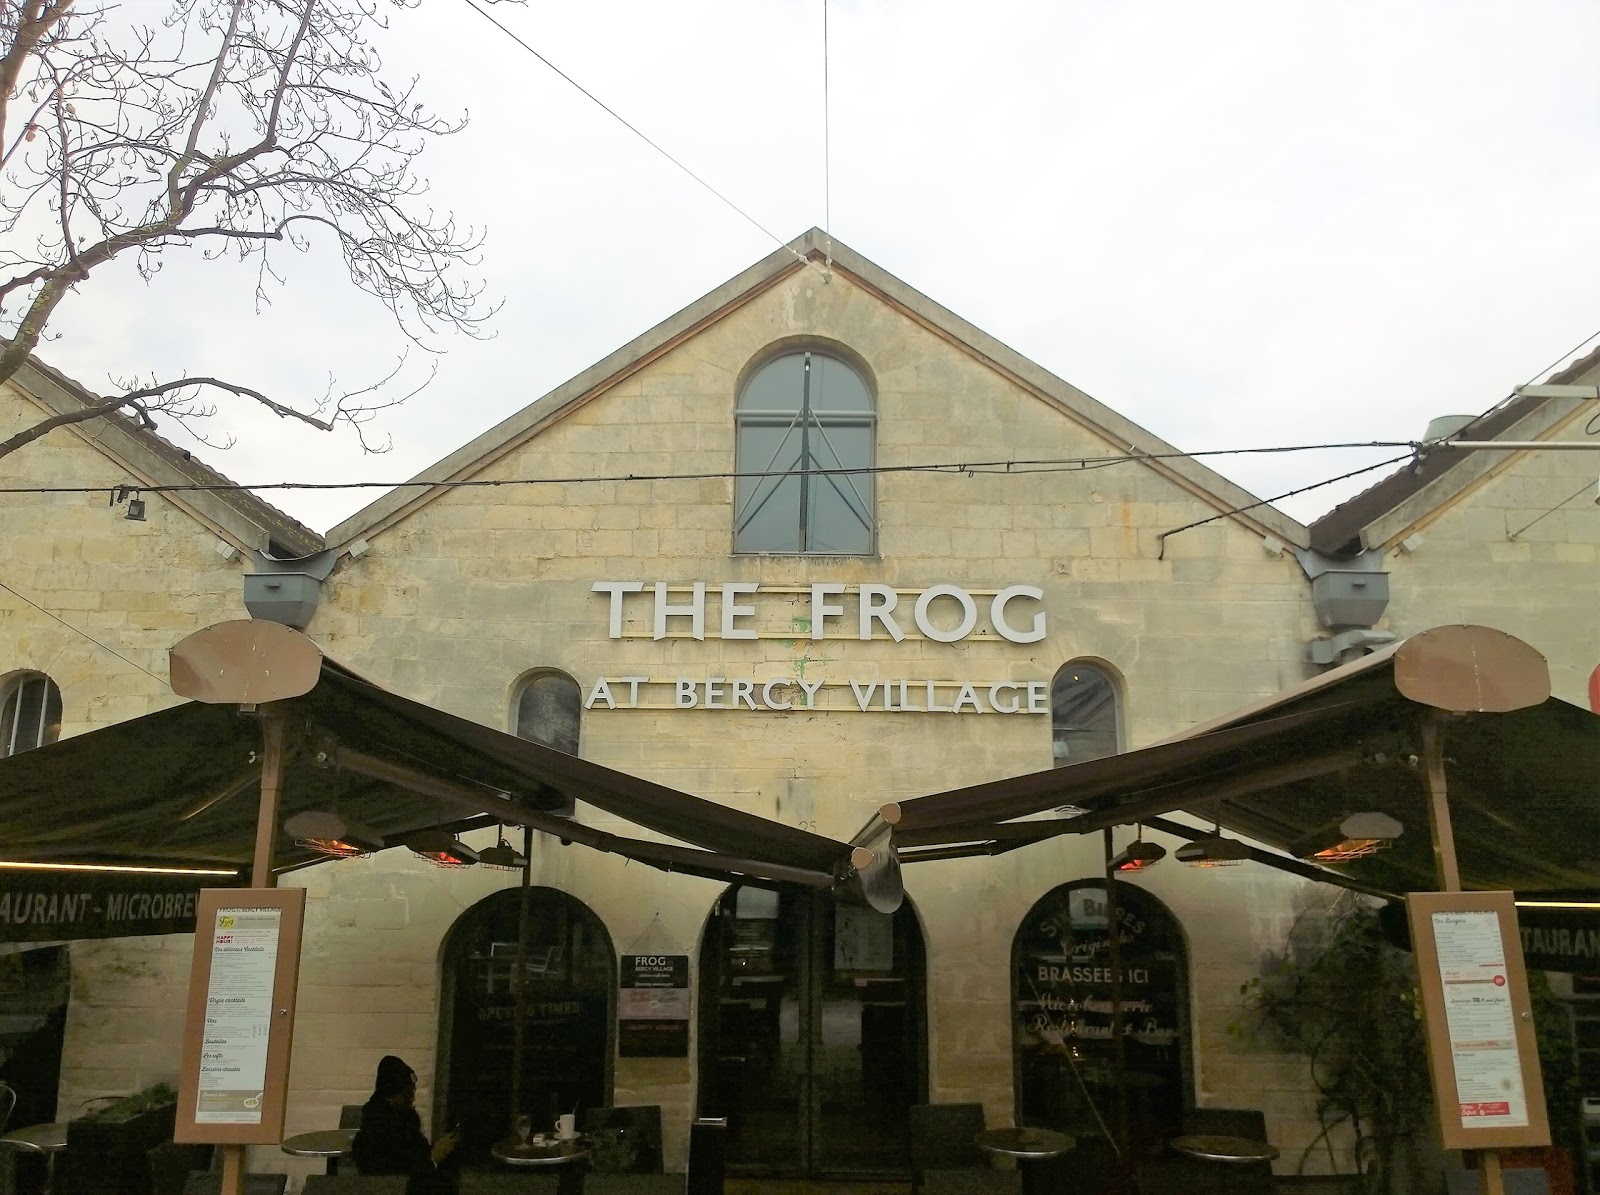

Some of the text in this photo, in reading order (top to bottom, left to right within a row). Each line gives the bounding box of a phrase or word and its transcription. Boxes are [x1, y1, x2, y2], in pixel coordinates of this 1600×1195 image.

[591, 582, 1047, 644] THE FROG
[584, 677, 1049, 714] AT BERCY VILLAGE
[106, 892, 199, 921] MICROBRE
[635, 956, 666, 966] FROG
[1129, 968, 1149, 984] ICI
